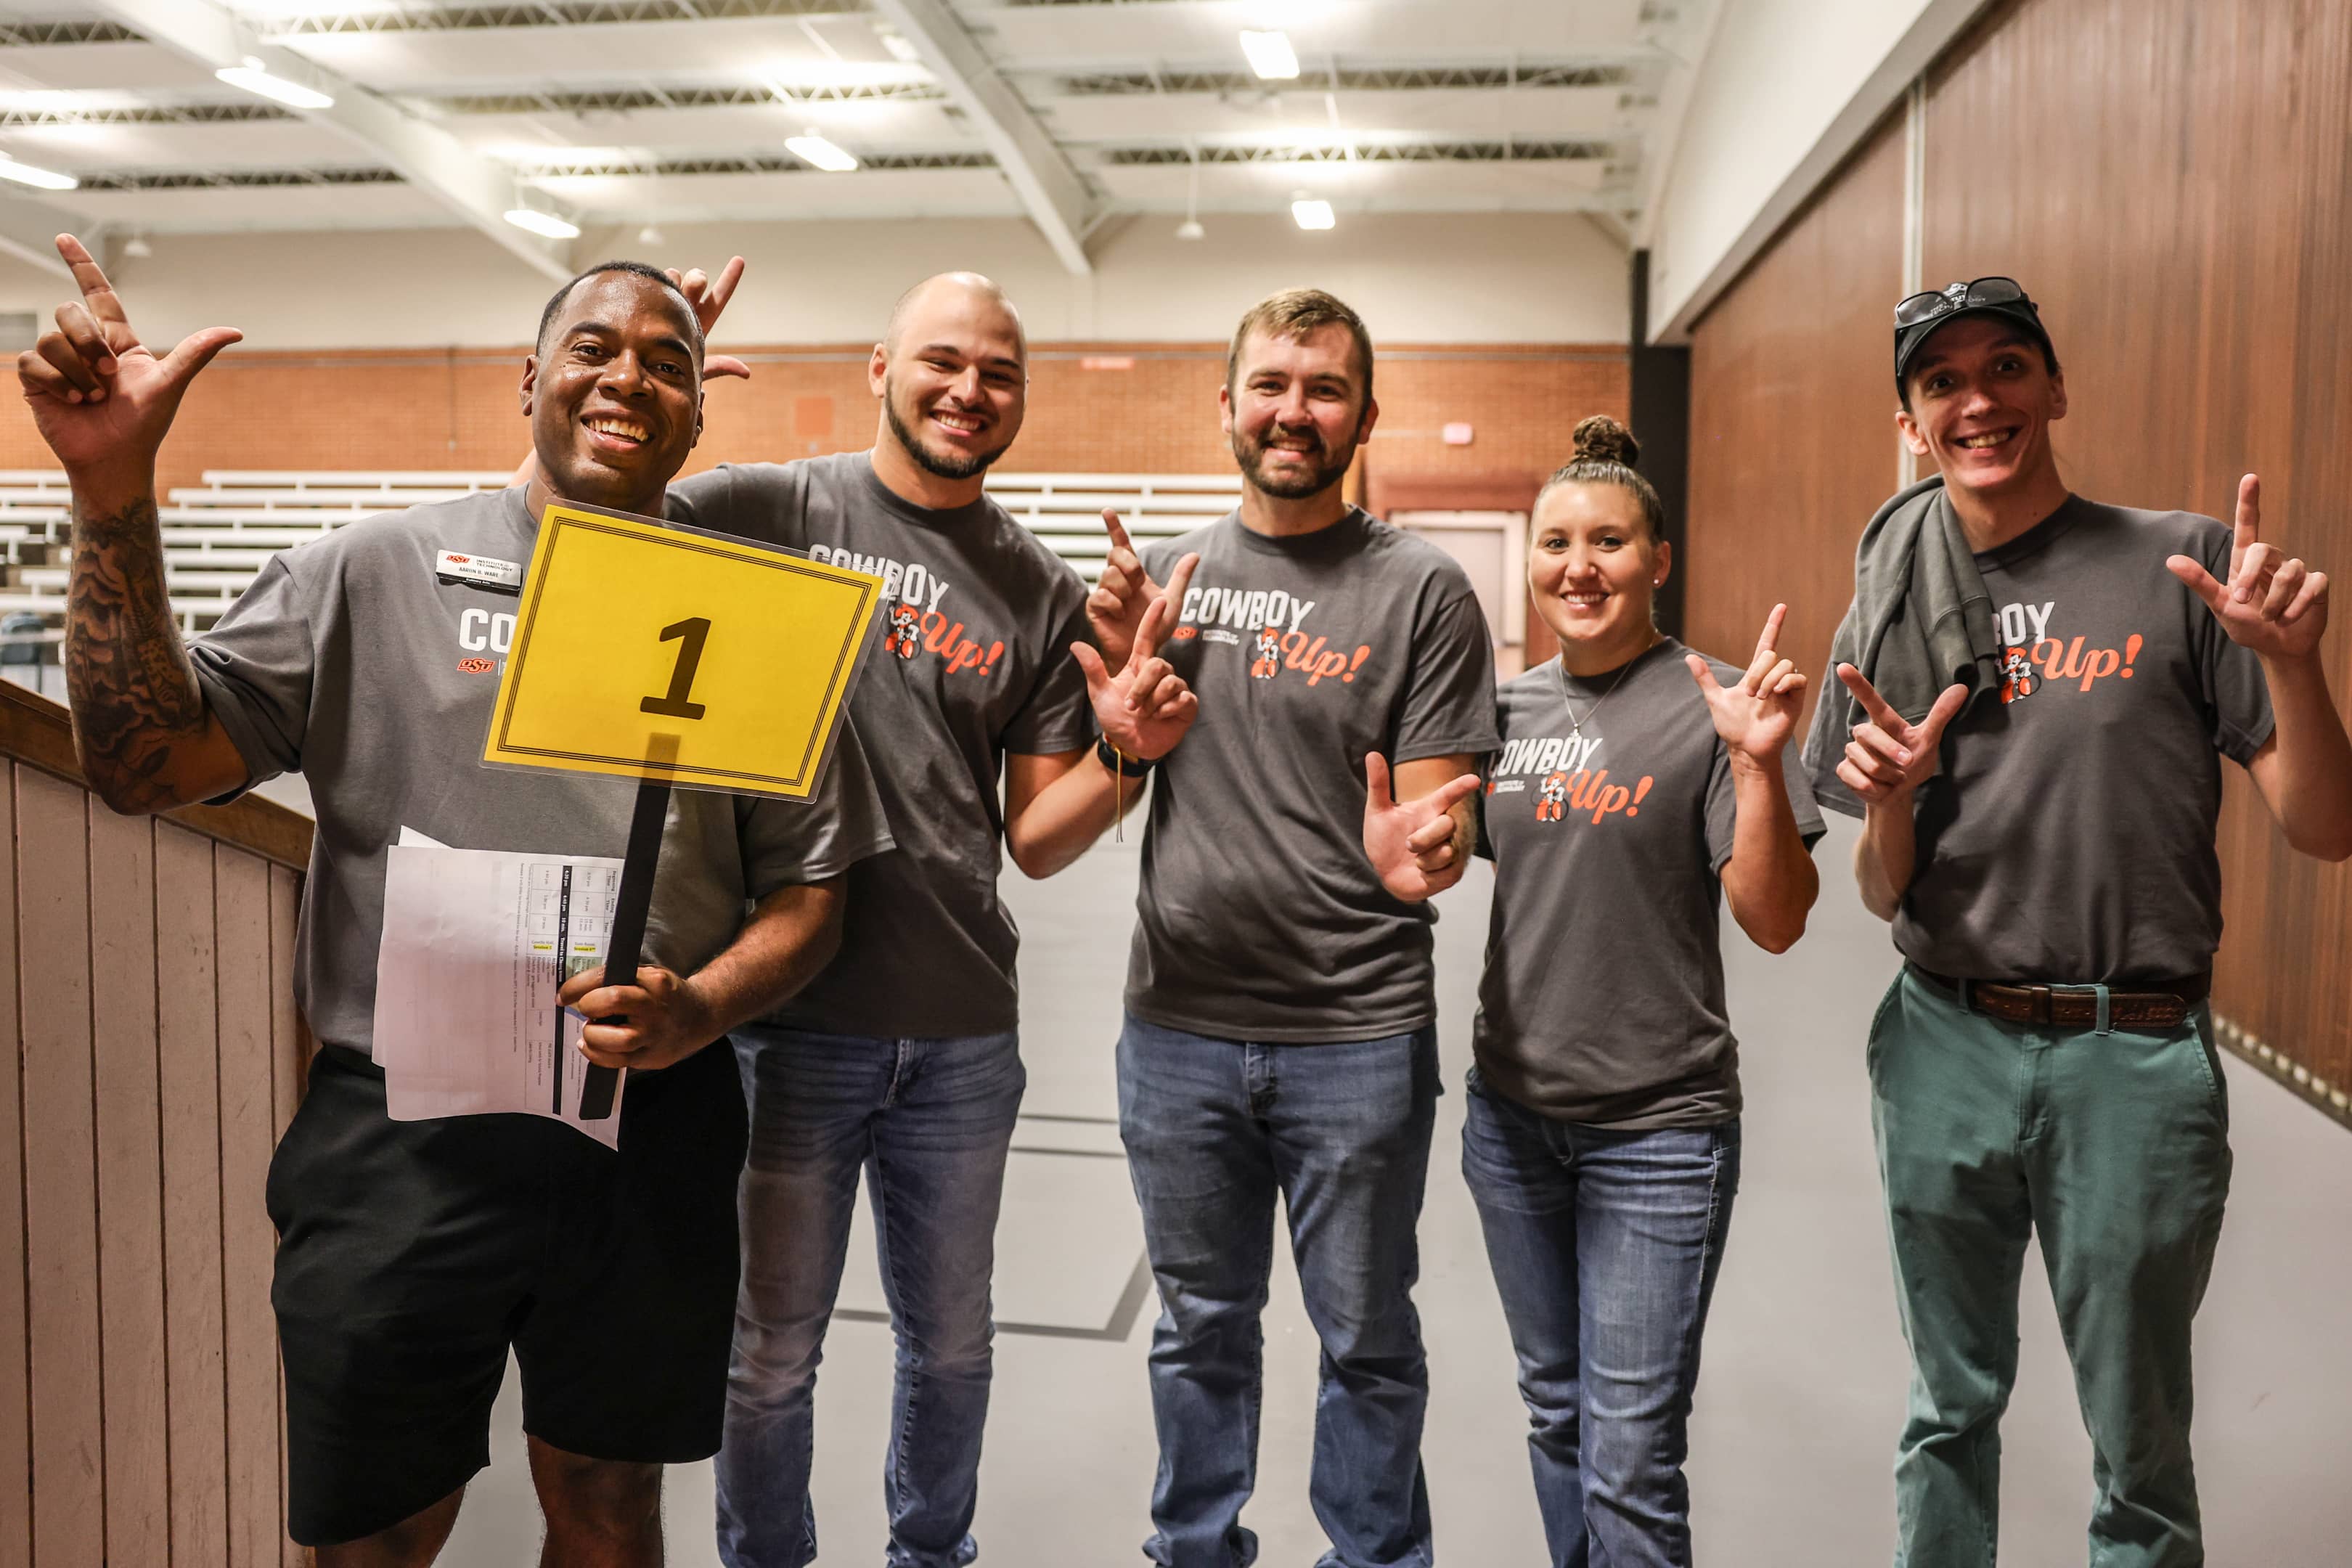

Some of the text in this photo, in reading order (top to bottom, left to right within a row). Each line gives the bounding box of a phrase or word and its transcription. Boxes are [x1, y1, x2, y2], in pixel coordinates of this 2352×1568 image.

[477, 563, 513, 572] TECHNOLOGY
[1179, 587, 1315, 634] COWBOY
[457, 657, 496, 674] OSU
[640, 617, 711, 720] 1
[920, 611, 1005, 676] Up!
[1279, 631, 1371, 686] Up!
[2031, 634, 2143, 692] Up!
[1566, 769, 1654, 825] Up!
